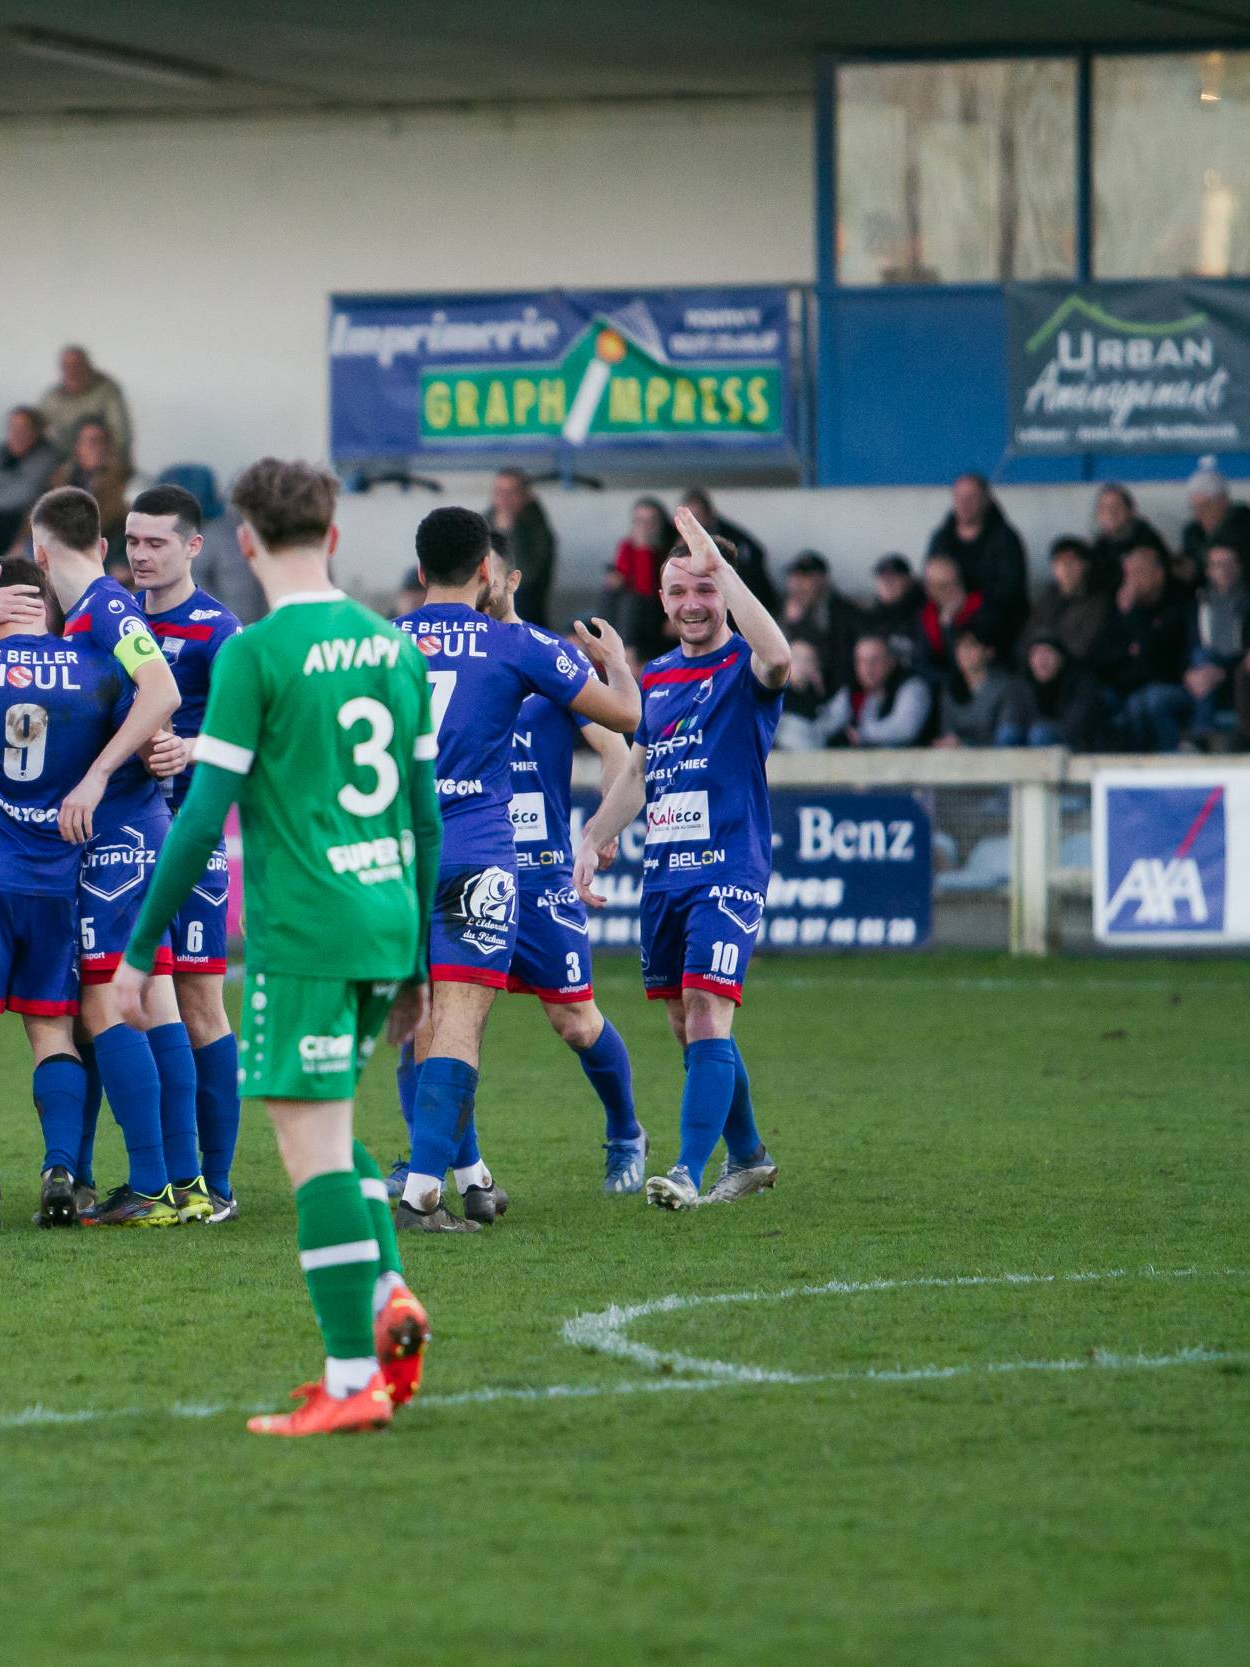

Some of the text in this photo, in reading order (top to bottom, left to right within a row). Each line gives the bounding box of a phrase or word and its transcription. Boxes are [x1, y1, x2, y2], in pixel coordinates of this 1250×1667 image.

[1057, 331, 1213, 371] URBAN
[424, 378, 567, 429] GRAPH
[418, 621, 488, 633] BELLER
[6, 651, 78, 665] BELLER
[411, 633, 487, 658] IOUL
[425, 670, 457, 746] 7
[3, 703, 48, 781] 9
[337, 696, 400, 818] 3
[798, 806, 916, 862] Benz
[1107, 857, 1209, 924] AXA
[81, 917, 96, 949] 5
[187, 921, 203, 952] 6
[463, 929, 477, 939] du
[177, 955, 209, 965] uhlsport
[565, 952, 581, 983] 3
[711, 941, 739, 975] 10
[559, 983, 588, 994] uhlsport
[702, 973, 736, 987] uhlsport
